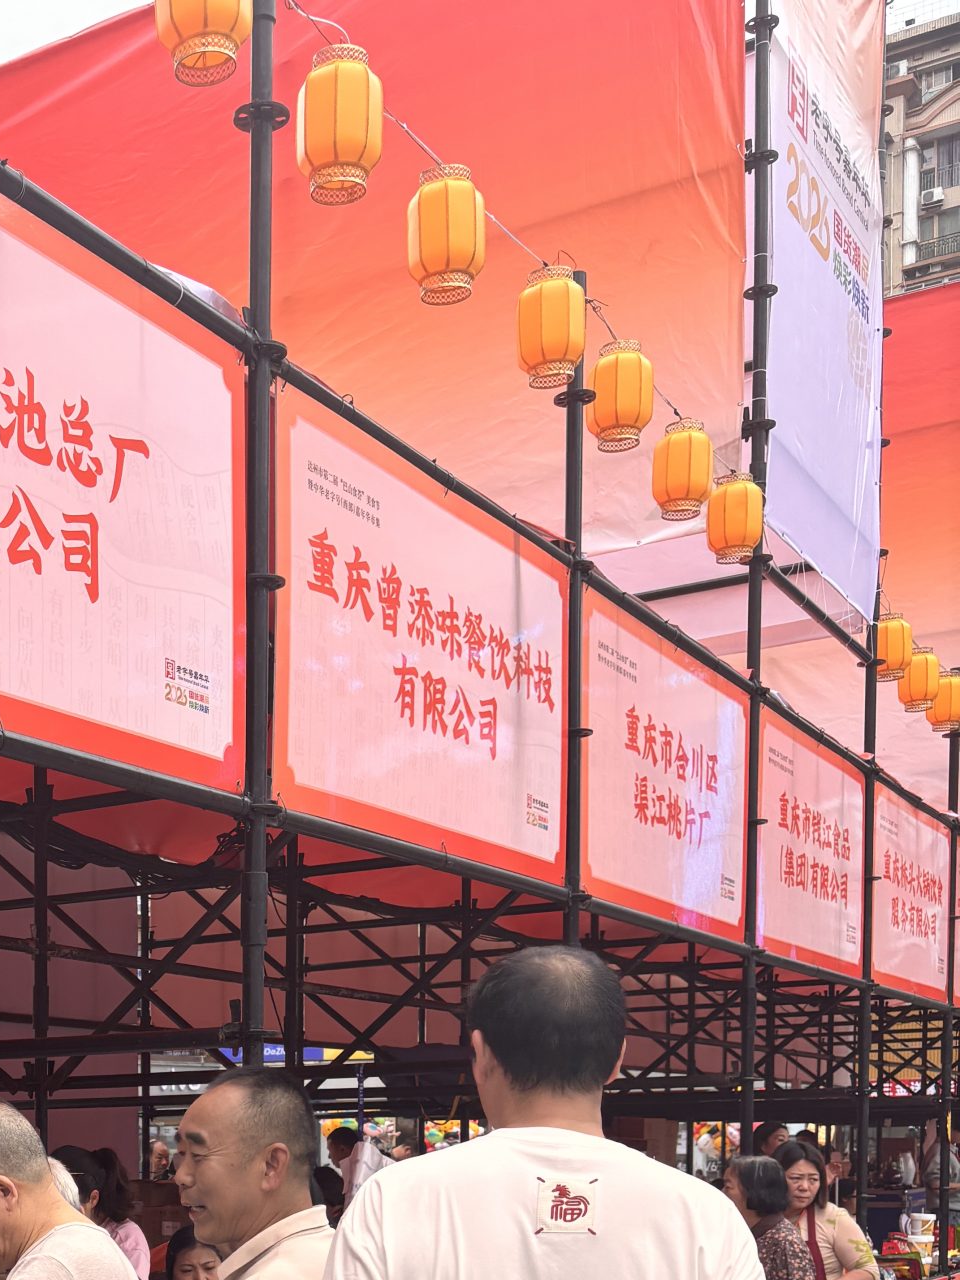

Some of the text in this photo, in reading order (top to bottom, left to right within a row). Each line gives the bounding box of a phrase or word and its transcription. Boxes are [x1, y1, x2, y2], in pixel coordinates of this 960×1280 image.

[787, 142, 830, 262] 2026
[307, 527, 555, 713] 重庆曾添味餐饮科技
[393, 654, 498, 761] 有限公司
[625, 704, 718, 796] 重庆市合川区
[634, 773, 711, 849] 渠江桃片厂
[891, 898, 937, 944] 服务有限公司
